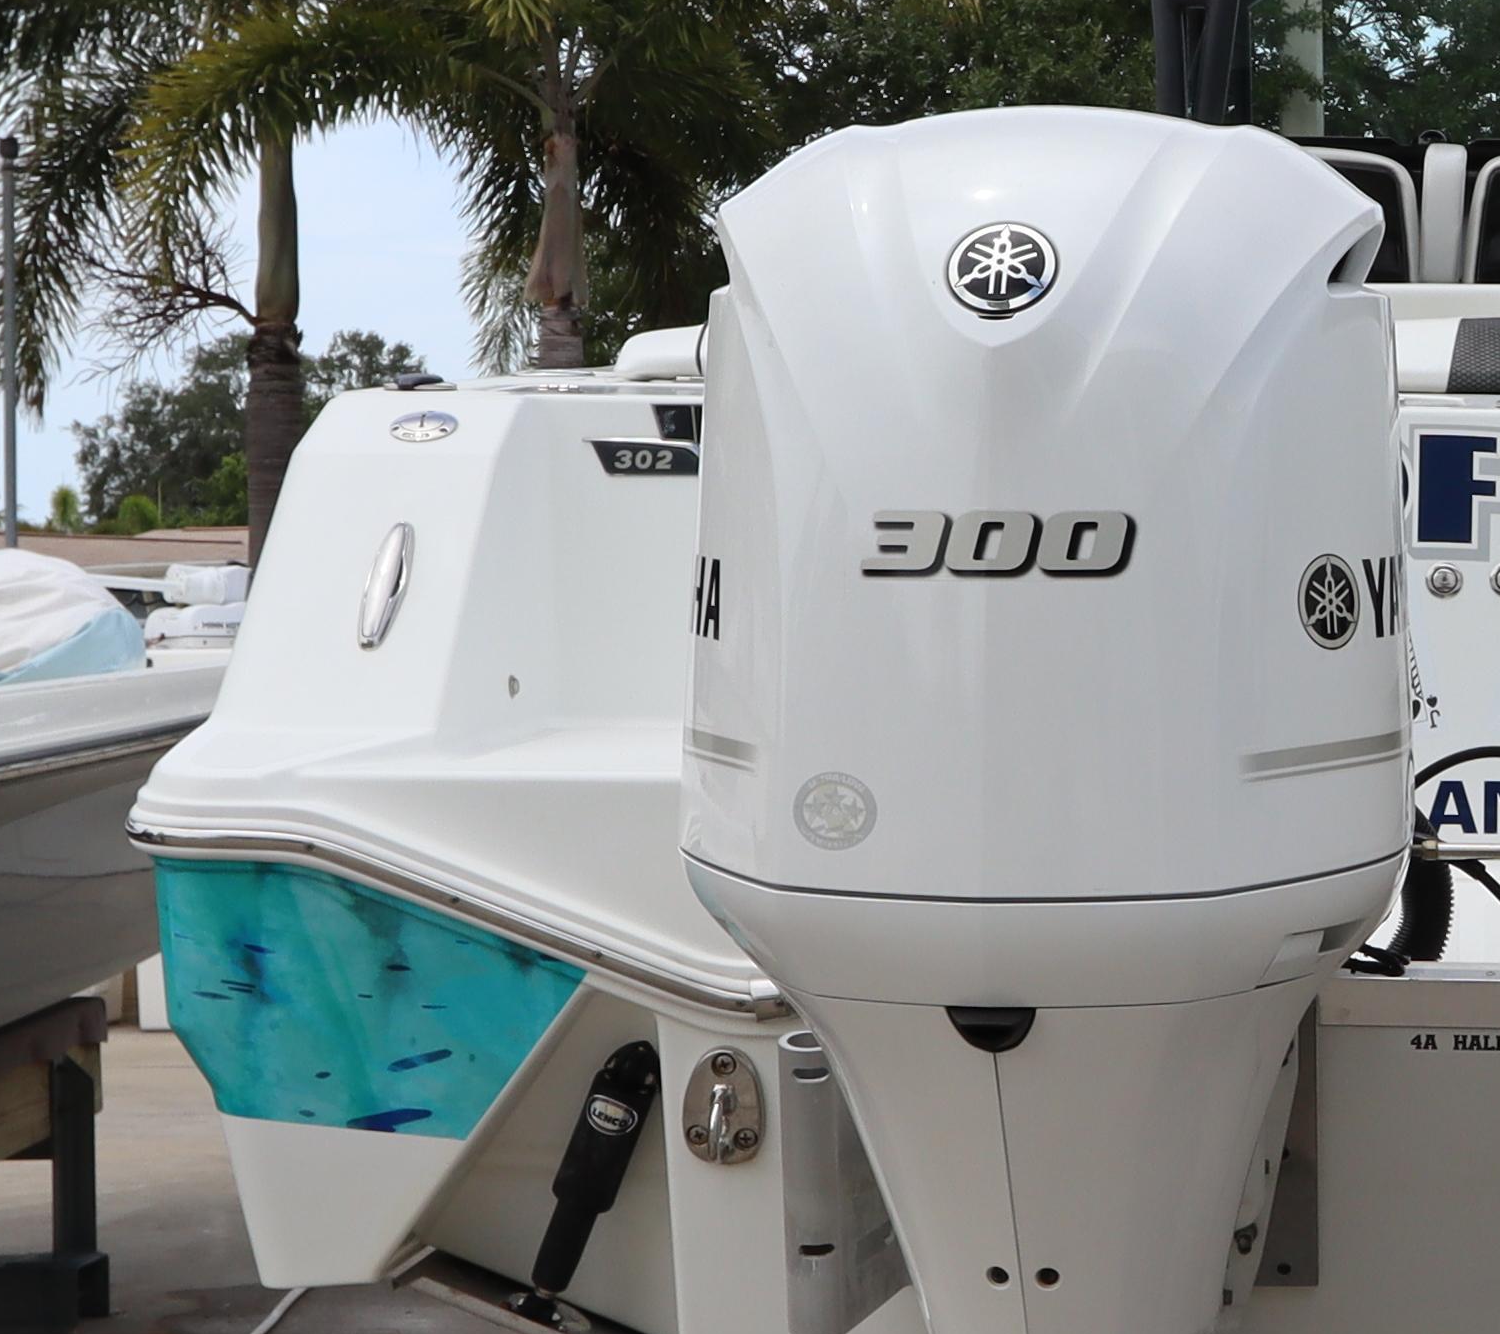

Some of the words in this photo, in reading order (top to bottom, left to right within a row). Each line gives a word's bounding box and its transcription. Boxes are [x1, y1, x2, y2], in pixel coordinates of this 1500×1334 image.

[613, 449, 674, 470] 302
[859, 510, 1137, 578] 300
[1362, 554, 1403, 638] YA
[1410, 1033, 1438, 1051] 4A
[592, 1106, 628, 1128] LENCO
